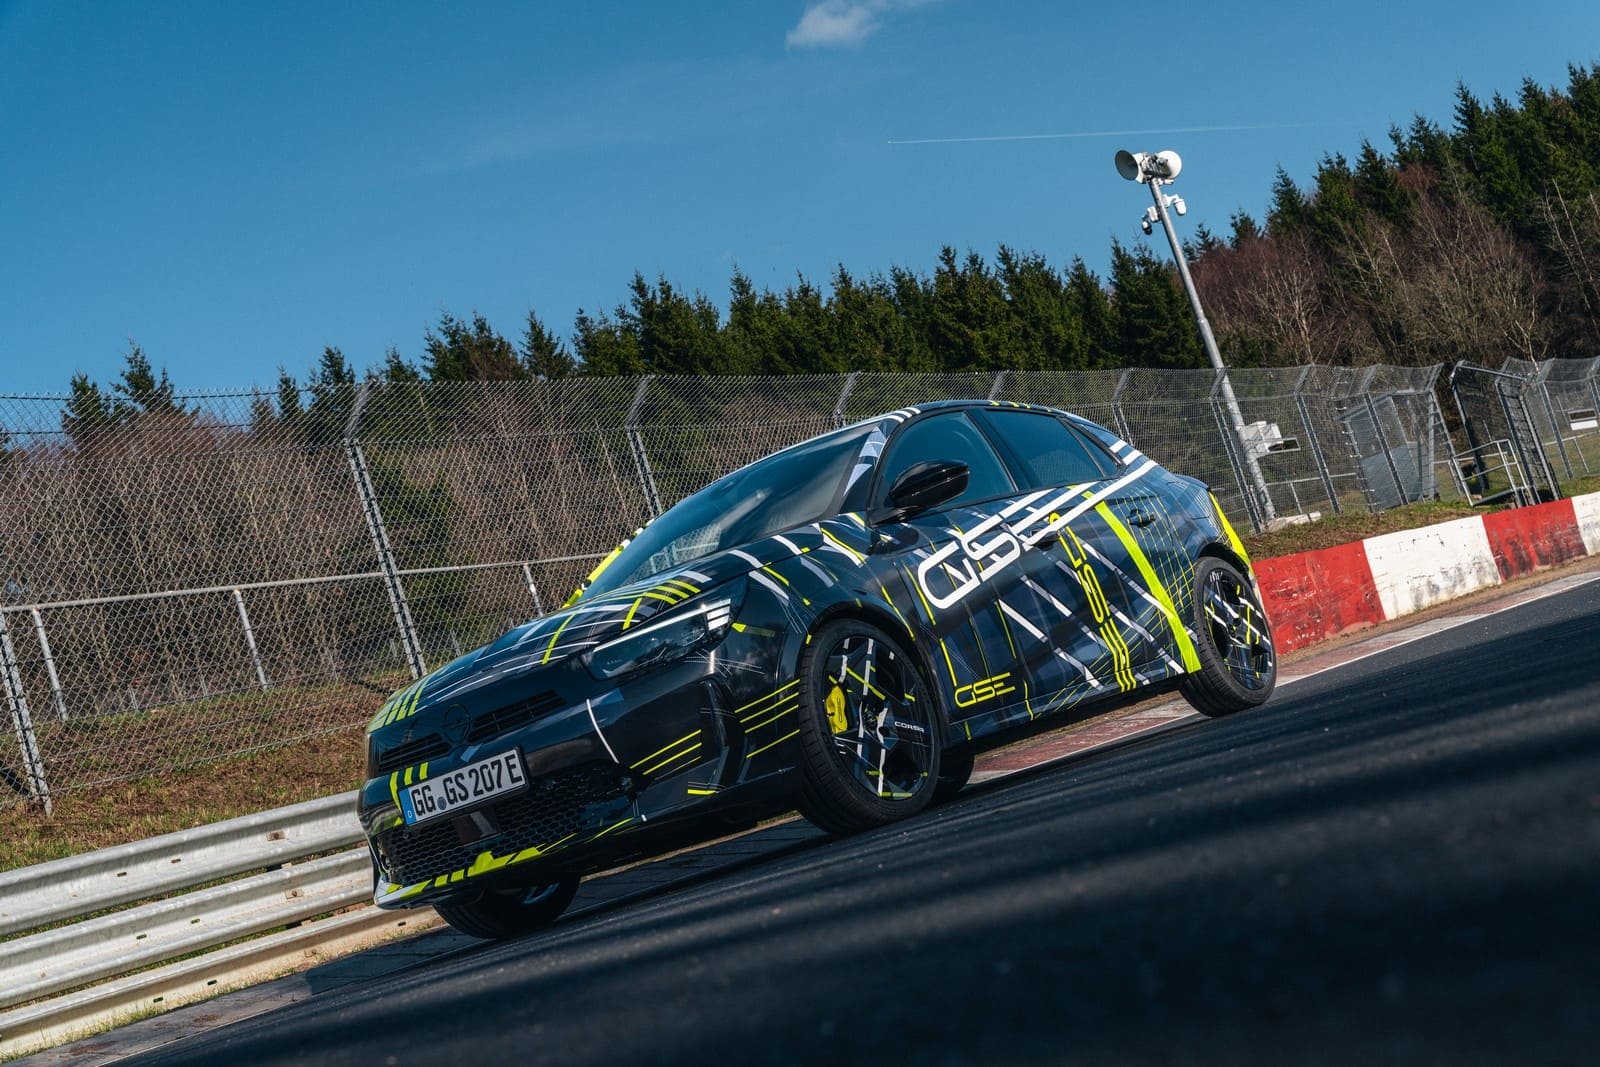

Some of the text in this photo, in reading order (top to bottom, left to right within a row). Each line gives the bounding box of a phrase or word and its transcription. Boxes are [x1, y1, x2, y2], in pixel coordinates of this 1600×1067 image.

[955, 672, 1016, 708] GSE
[894, 721, 925, 733] CORSA
[411, 785, 437, 817] GG
[443, 773, 469, 805] GS
